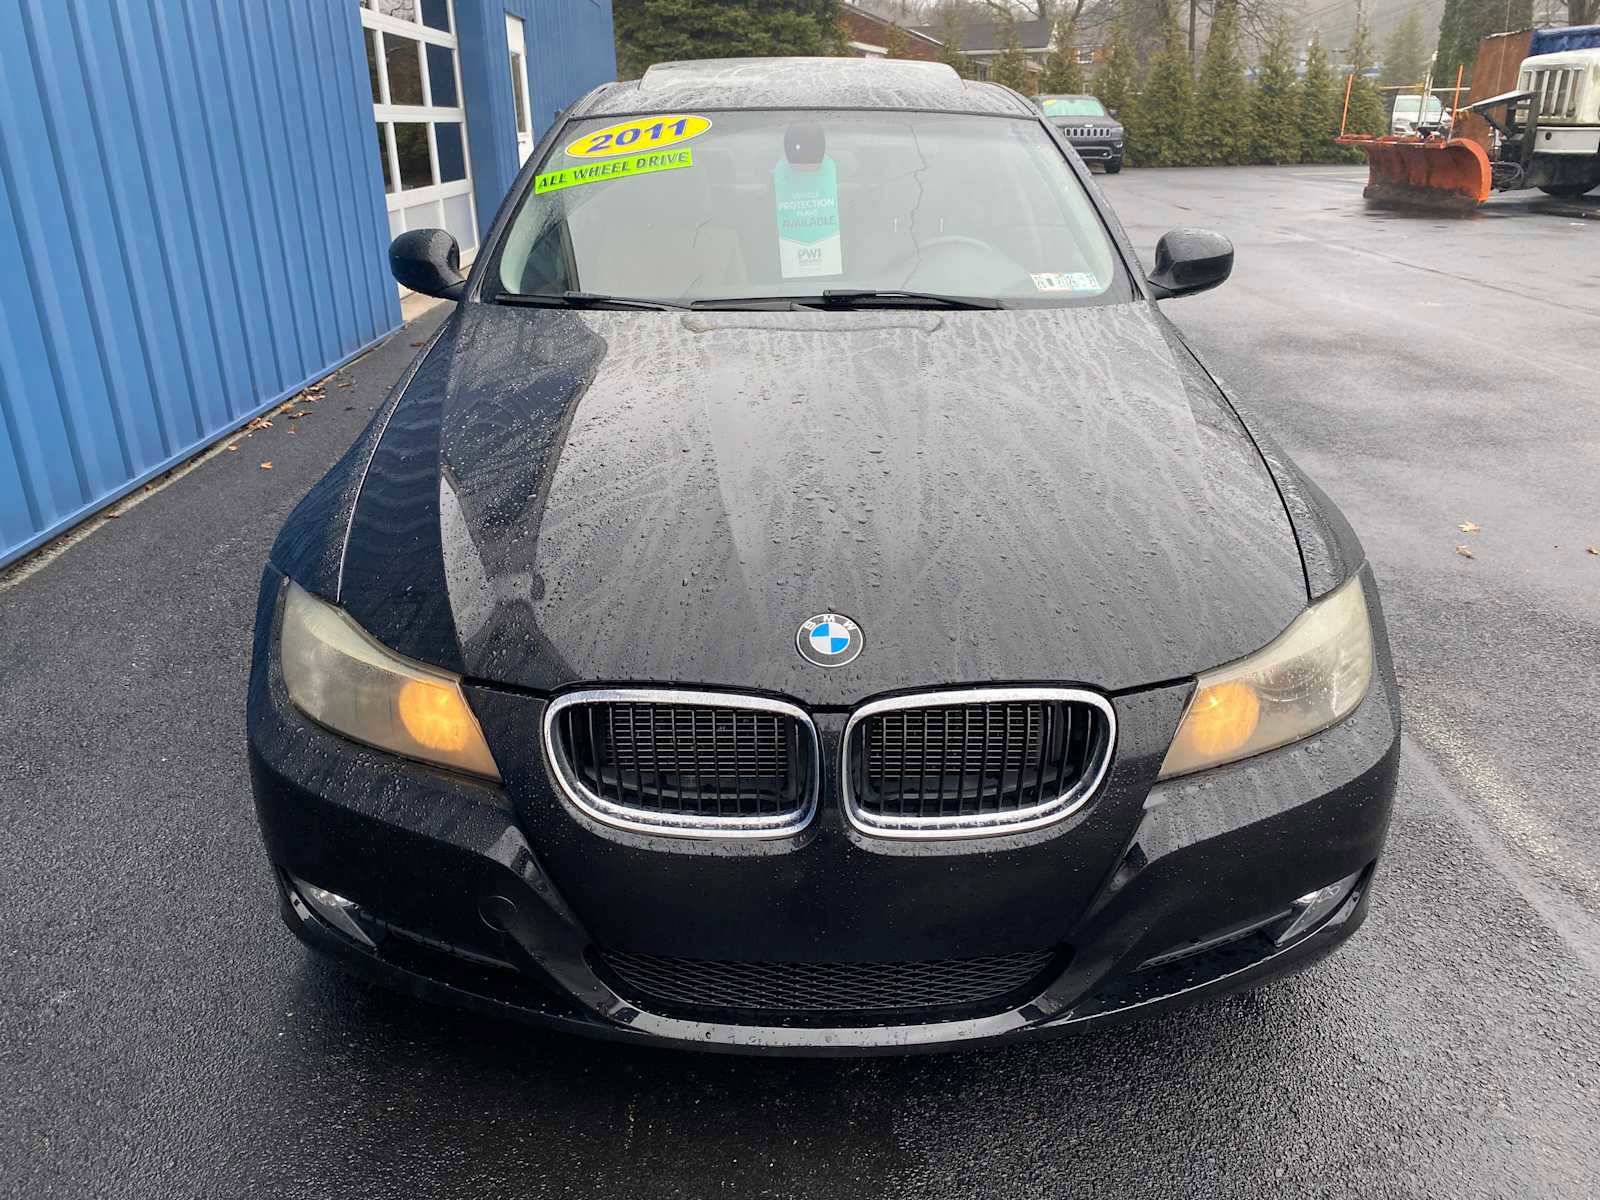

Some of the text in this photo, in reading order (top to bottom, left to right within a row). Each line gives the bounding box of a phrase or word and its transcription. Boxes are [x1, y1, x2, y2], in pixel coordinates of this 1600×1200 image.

[586, 118, 688, 153] 2011
[537, 151, 690, 190] ALL WHEEL DRIVE
[778, 197, 836, 210] PROTECTION
[783, 215, 837, 229] AVAILABLE
[802, 614, 857, 631] BMW
